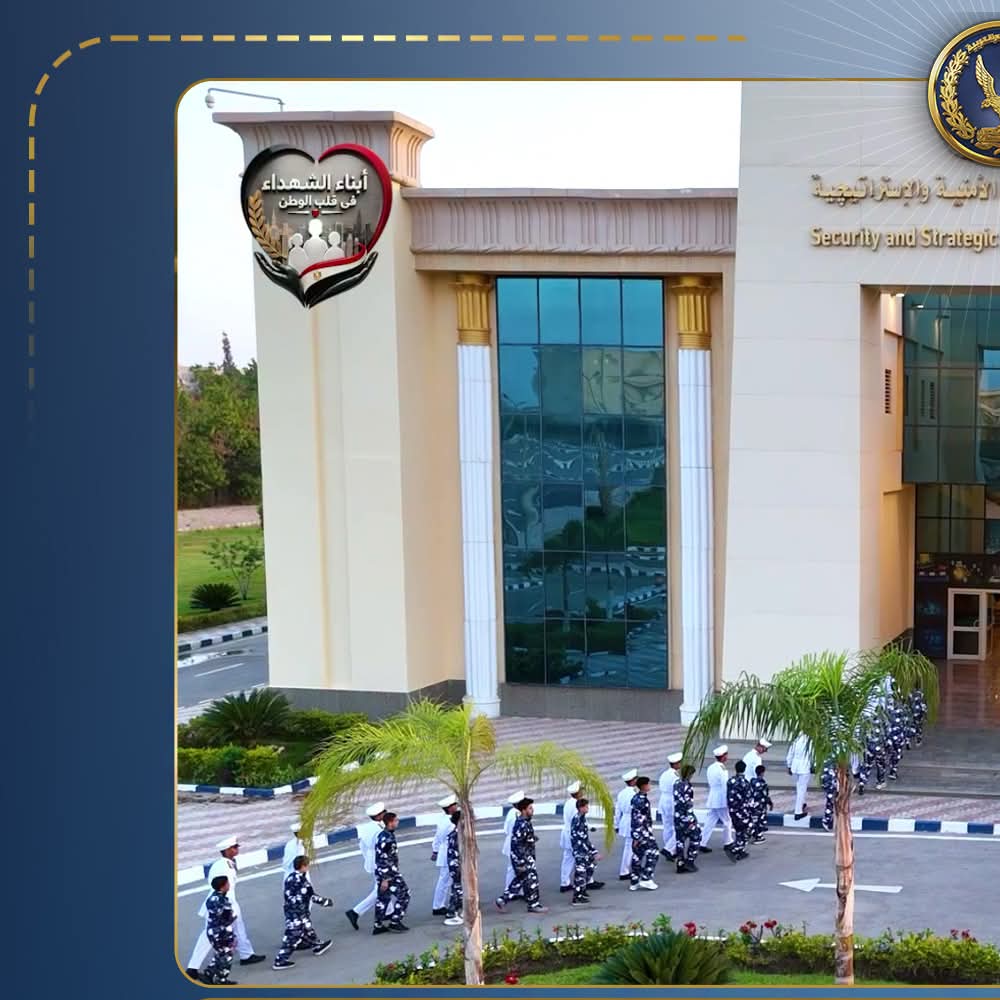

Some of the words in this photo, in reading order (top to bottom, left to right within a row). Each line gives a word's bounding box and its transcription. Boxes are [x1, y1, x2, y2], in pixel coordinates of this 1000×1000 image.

[935, 174, 997, 207] الأمنية
[811, 228, 881, 252] Security
[886, 228, 917, 248] and
[921, 227, 999, 254] Strategic
